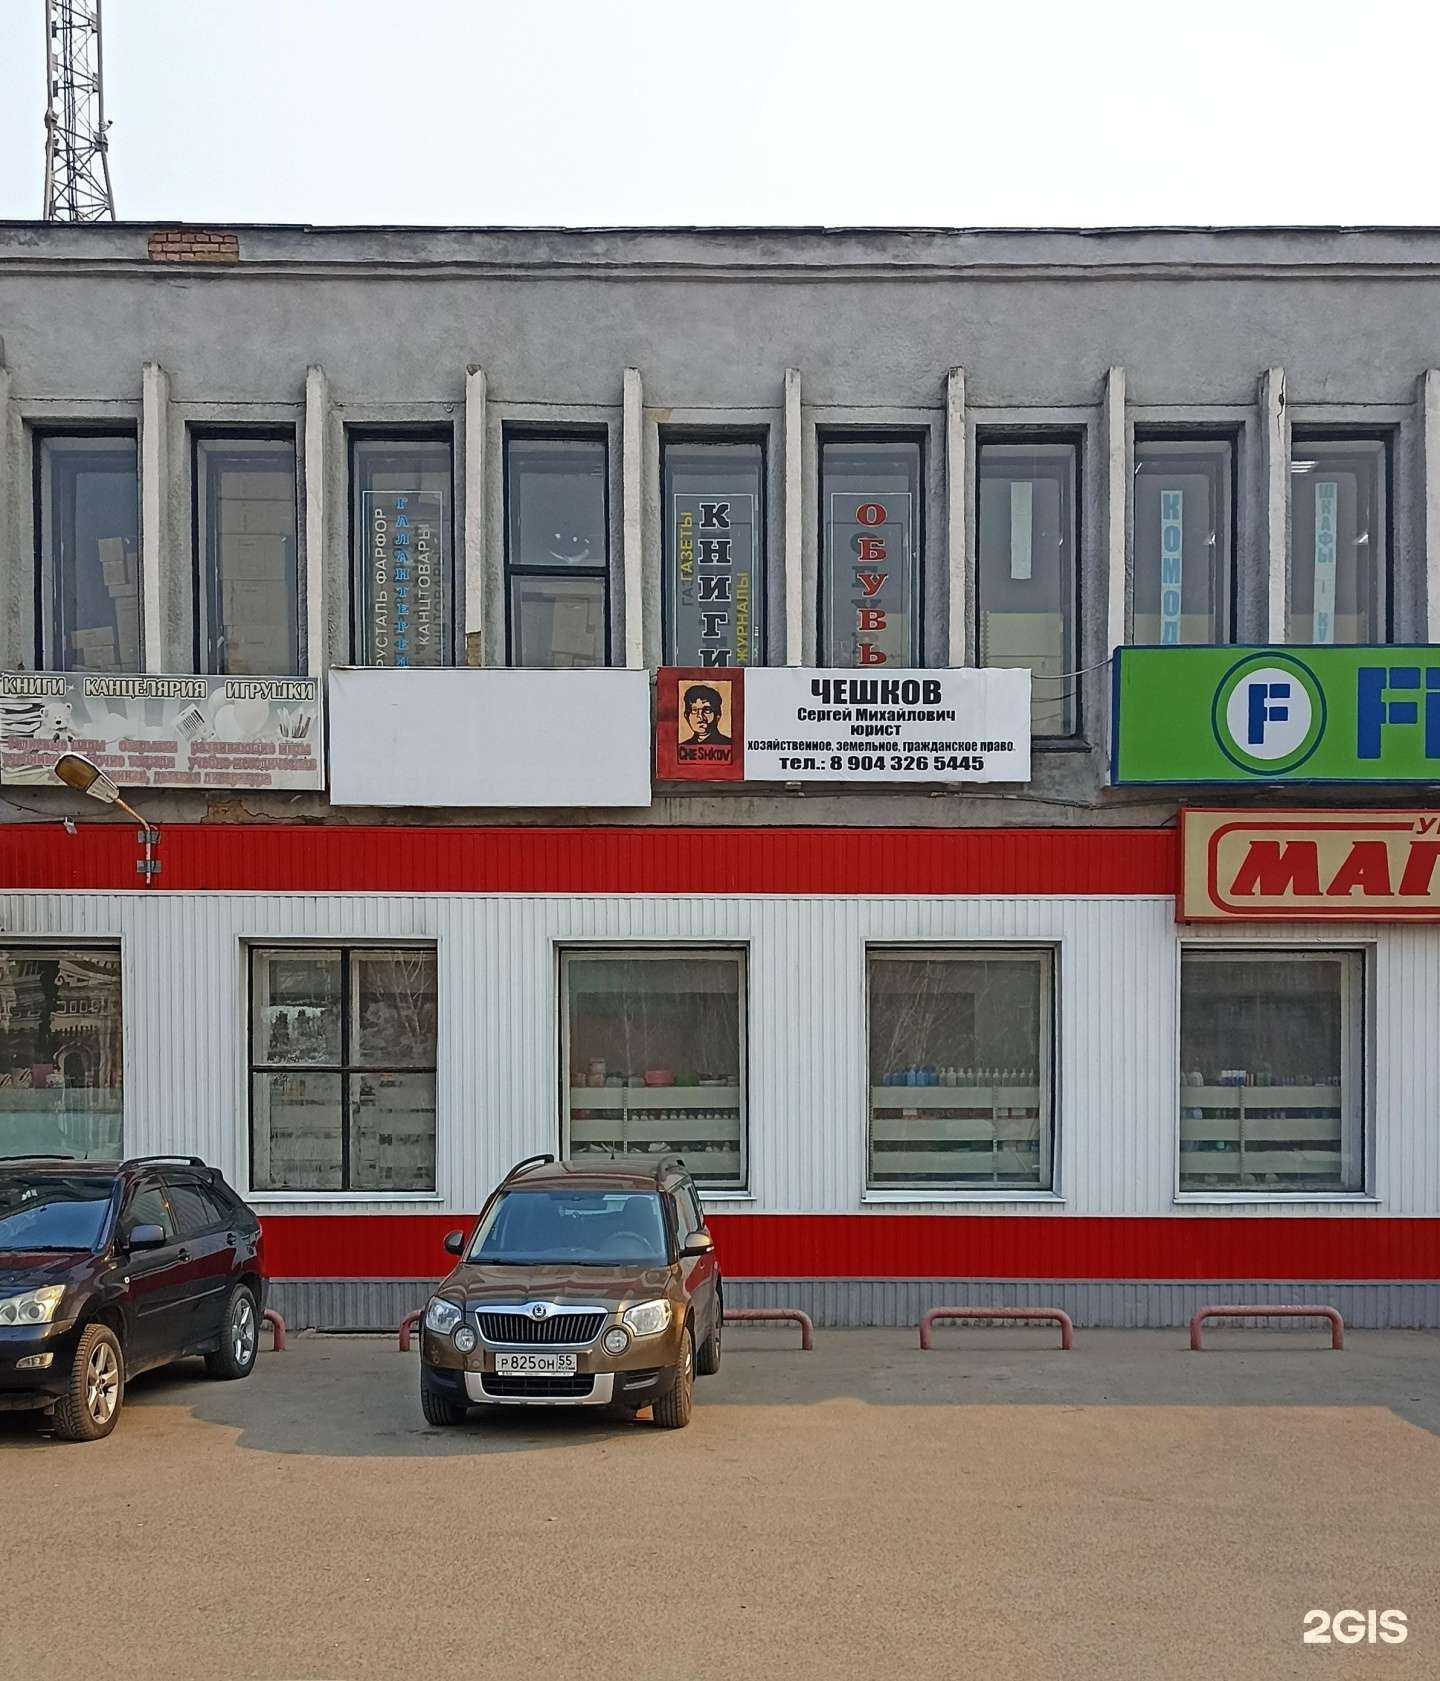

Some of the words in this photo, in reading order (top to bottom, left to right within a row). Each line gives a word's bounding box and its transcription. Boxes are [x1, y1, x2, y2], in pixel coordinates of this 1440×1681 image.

[1317, 484, 1334, 563] ШКАФЫ
[375, 508, 388, 585] ФАРФОР
[680, 511, 693, 581] ГАЗЕТЫ
[698, 502, 732, 667] КНИГИ
[855, 502, 888, 666] ОБУВЬ
[736, 570, 748, 662] ЖУРНАЛЫ
[2, 675, 66, 697] КНИГИ
[84, 677, 207, 699] КАНЦЕЛЯРИЯ
[225, 680, 315, 700] ИГРУШКИ
[810, 679, 942, 705] ЧЕШКОВ
[797, 707, 851, 722] Сергей
[855, 708, 956, 722] Михайлович
[850, 724, 902, 737] юрист
[747, 740, 834, 752] хозяйственное,
[836, 740, 901, 752] земельное,
[903, 741, 978, 753] гражданское
[980, 741, 1016, 752] право.
[779, 757, 826, 770] тел.:
[830, 756, 843, 770] 8
[847, 756, 886, 771] 904
[890, 756, 929, 771] 326
[933, 756, 985, 771] 5445
[558, 1355, 573, 1366] 55
